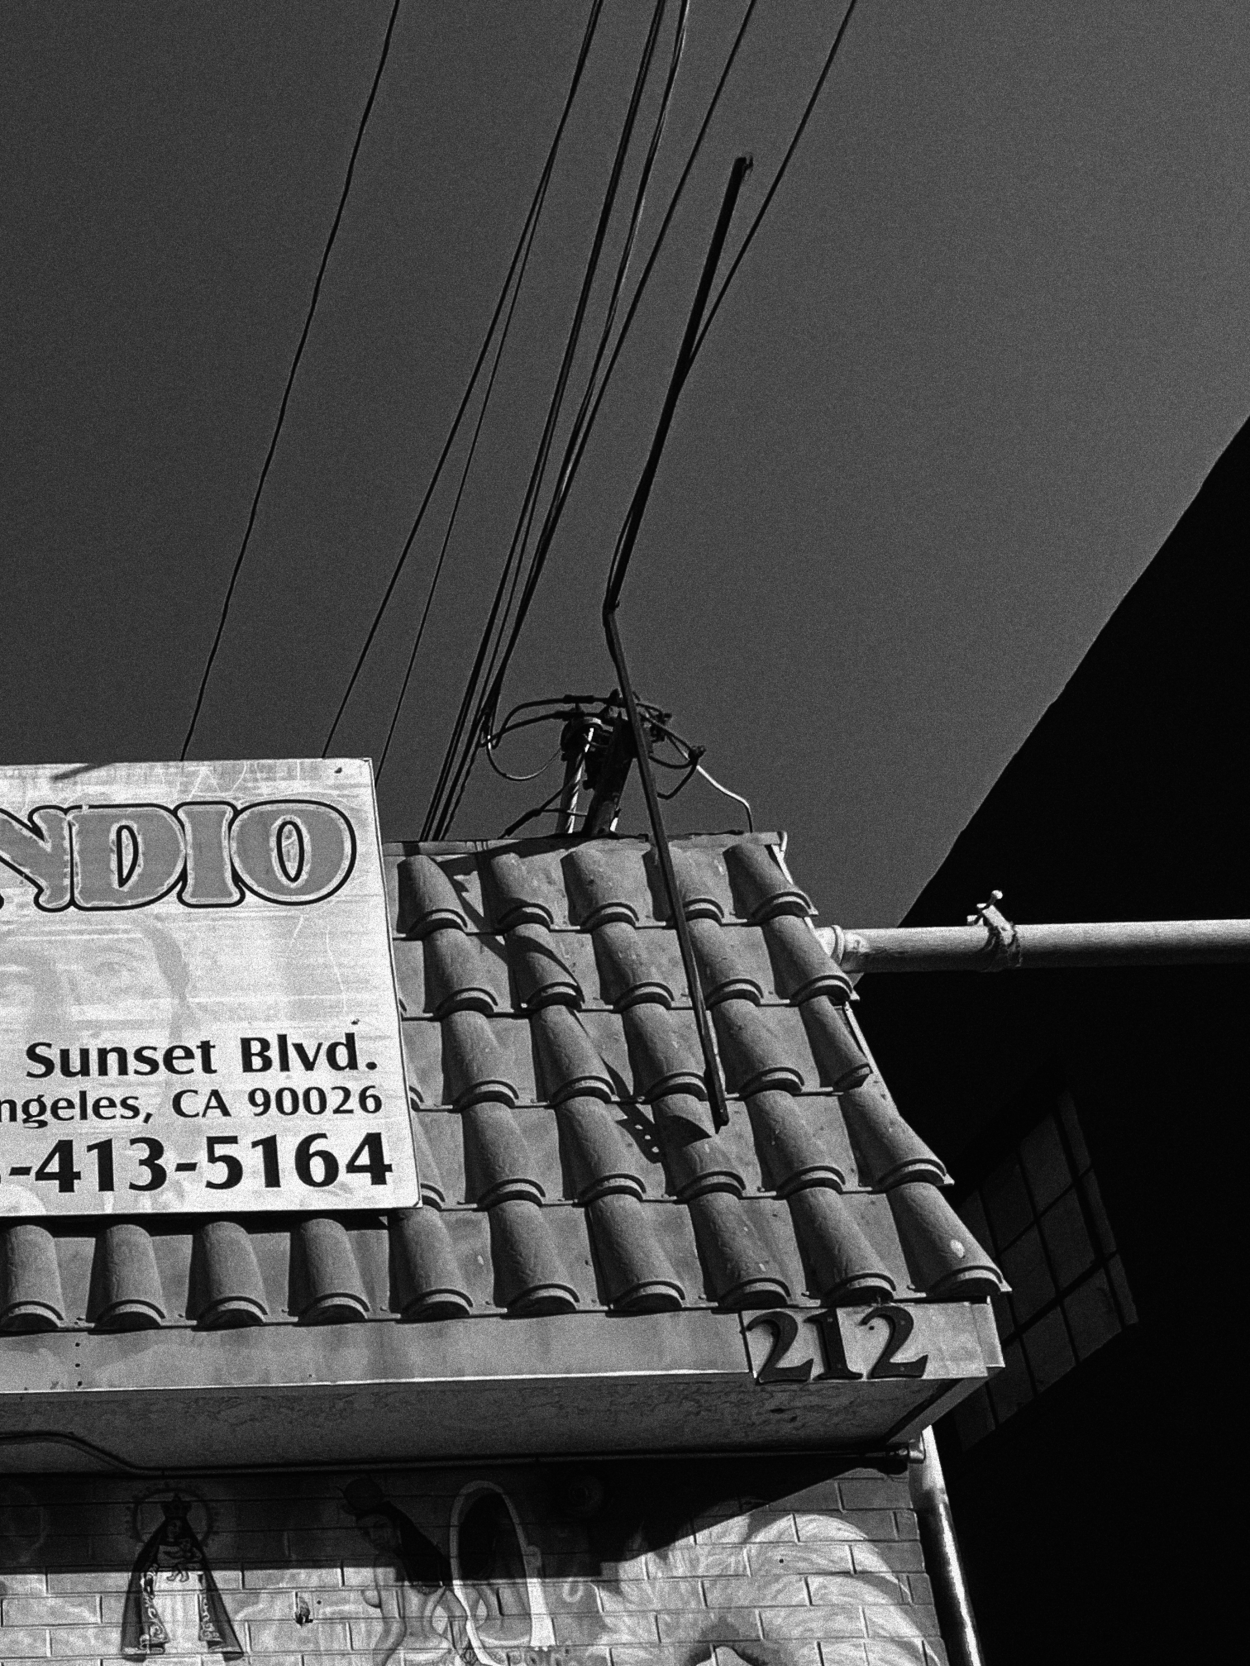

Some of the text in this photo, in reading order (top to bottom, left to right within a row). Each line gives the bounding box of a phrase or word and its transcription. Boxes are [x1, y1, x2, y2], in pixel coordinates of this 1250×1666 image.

[25, 1038, 218, 1078] Sunset
[241, 1032, 378, 1074] Blvd.
[171, 1087, 232, 1119] CA
[247, 1084, 384, 1117] 90026
[746, 1306, 928, 1385] 212
